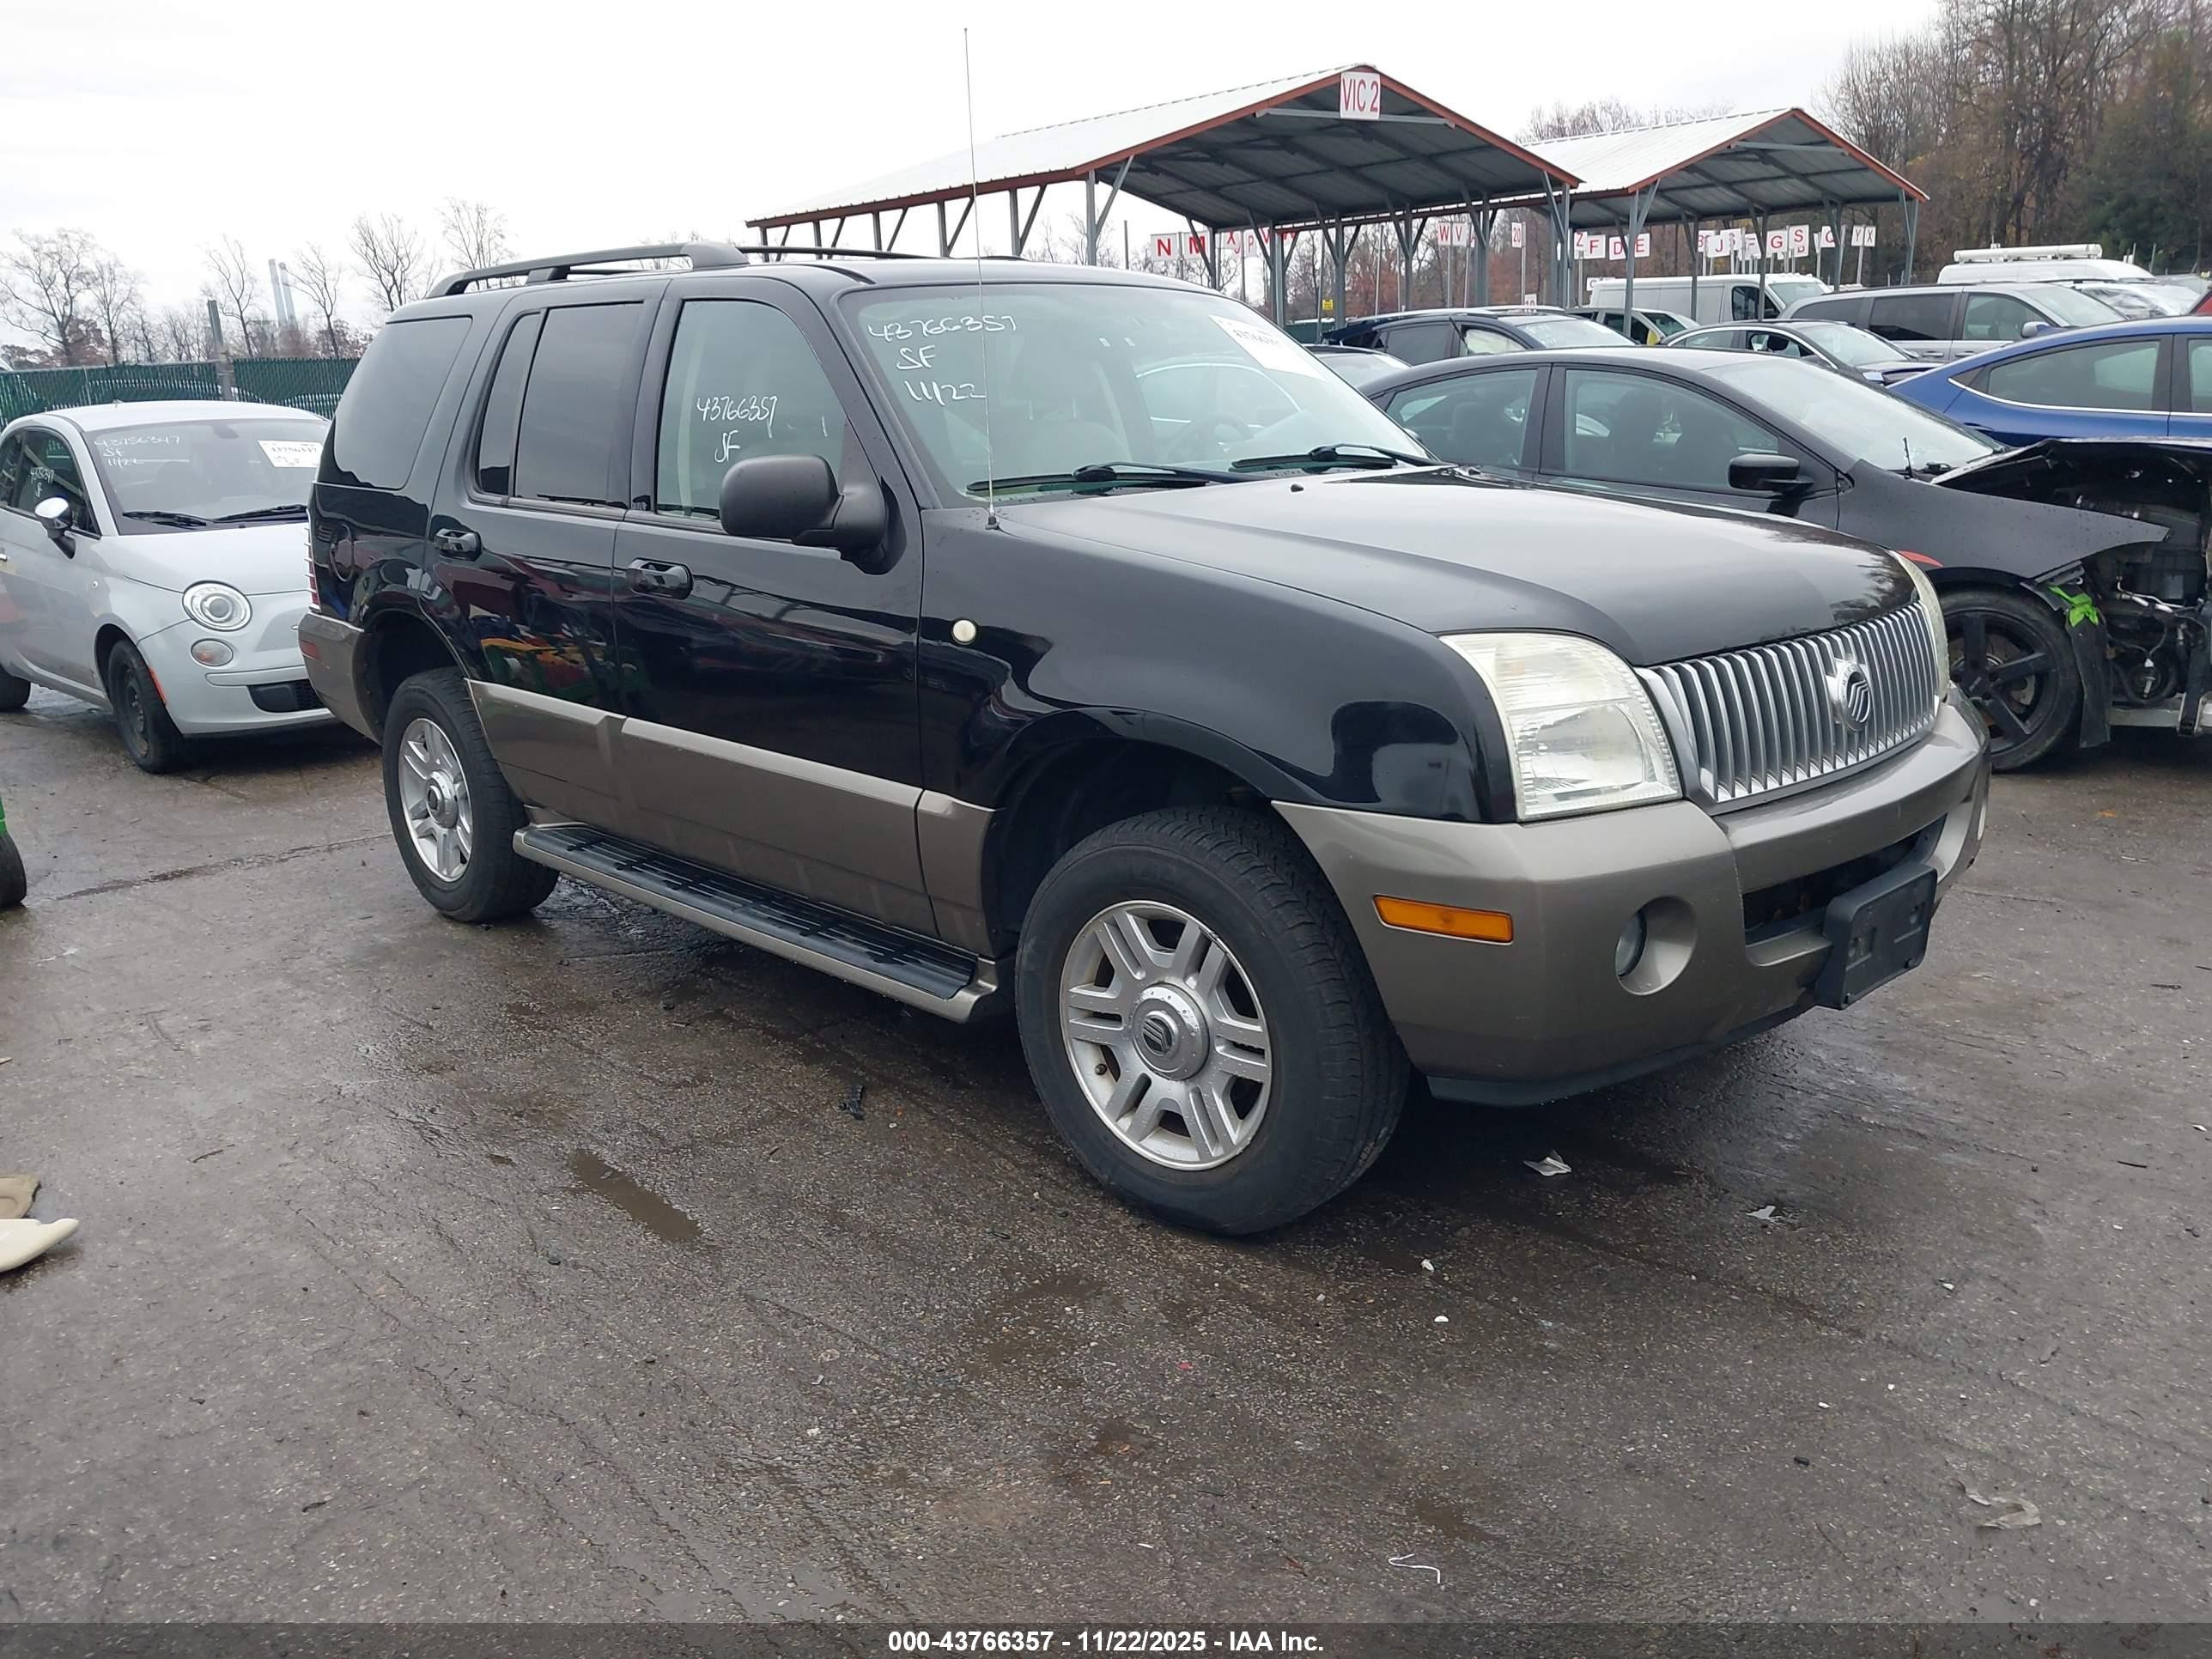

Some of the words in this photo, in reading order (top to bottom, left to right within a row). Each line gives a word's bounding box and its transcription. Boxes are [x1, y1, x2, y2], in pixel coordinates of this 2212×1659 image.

[1342, 77, 1367, 112] VIC
[1370, 80, 1379, 112] 2
[1227, 230, 1237, 246] X
[1438, 225, 1449, 241] W
[1455, 226, 1463, 241] V
[1513, 227, 1521, 242] 20
[1576, 231, 1583, 247] Z
[1794, 228, 1803, 243] S
[1855, 229, 1862, 242] Y
[1868, 229, 1873, 242] X
[1157, 238, 1171, 257] N
[1188, 235, 1206, 255] M
[1589, 240, 1600, 255] F
[1613, 241, 1623, 255] D
[1636, 239, 1645, 253] E
[1715, 239, 1723, 252] J
[1771, 235, 1784, 249] G
[868, 314, 1017, 342] 43766357
[896, 344, 937, 370] SF
[904, 380, 987, 406] 11/22
[696, 395, 778, 427] 43766357
